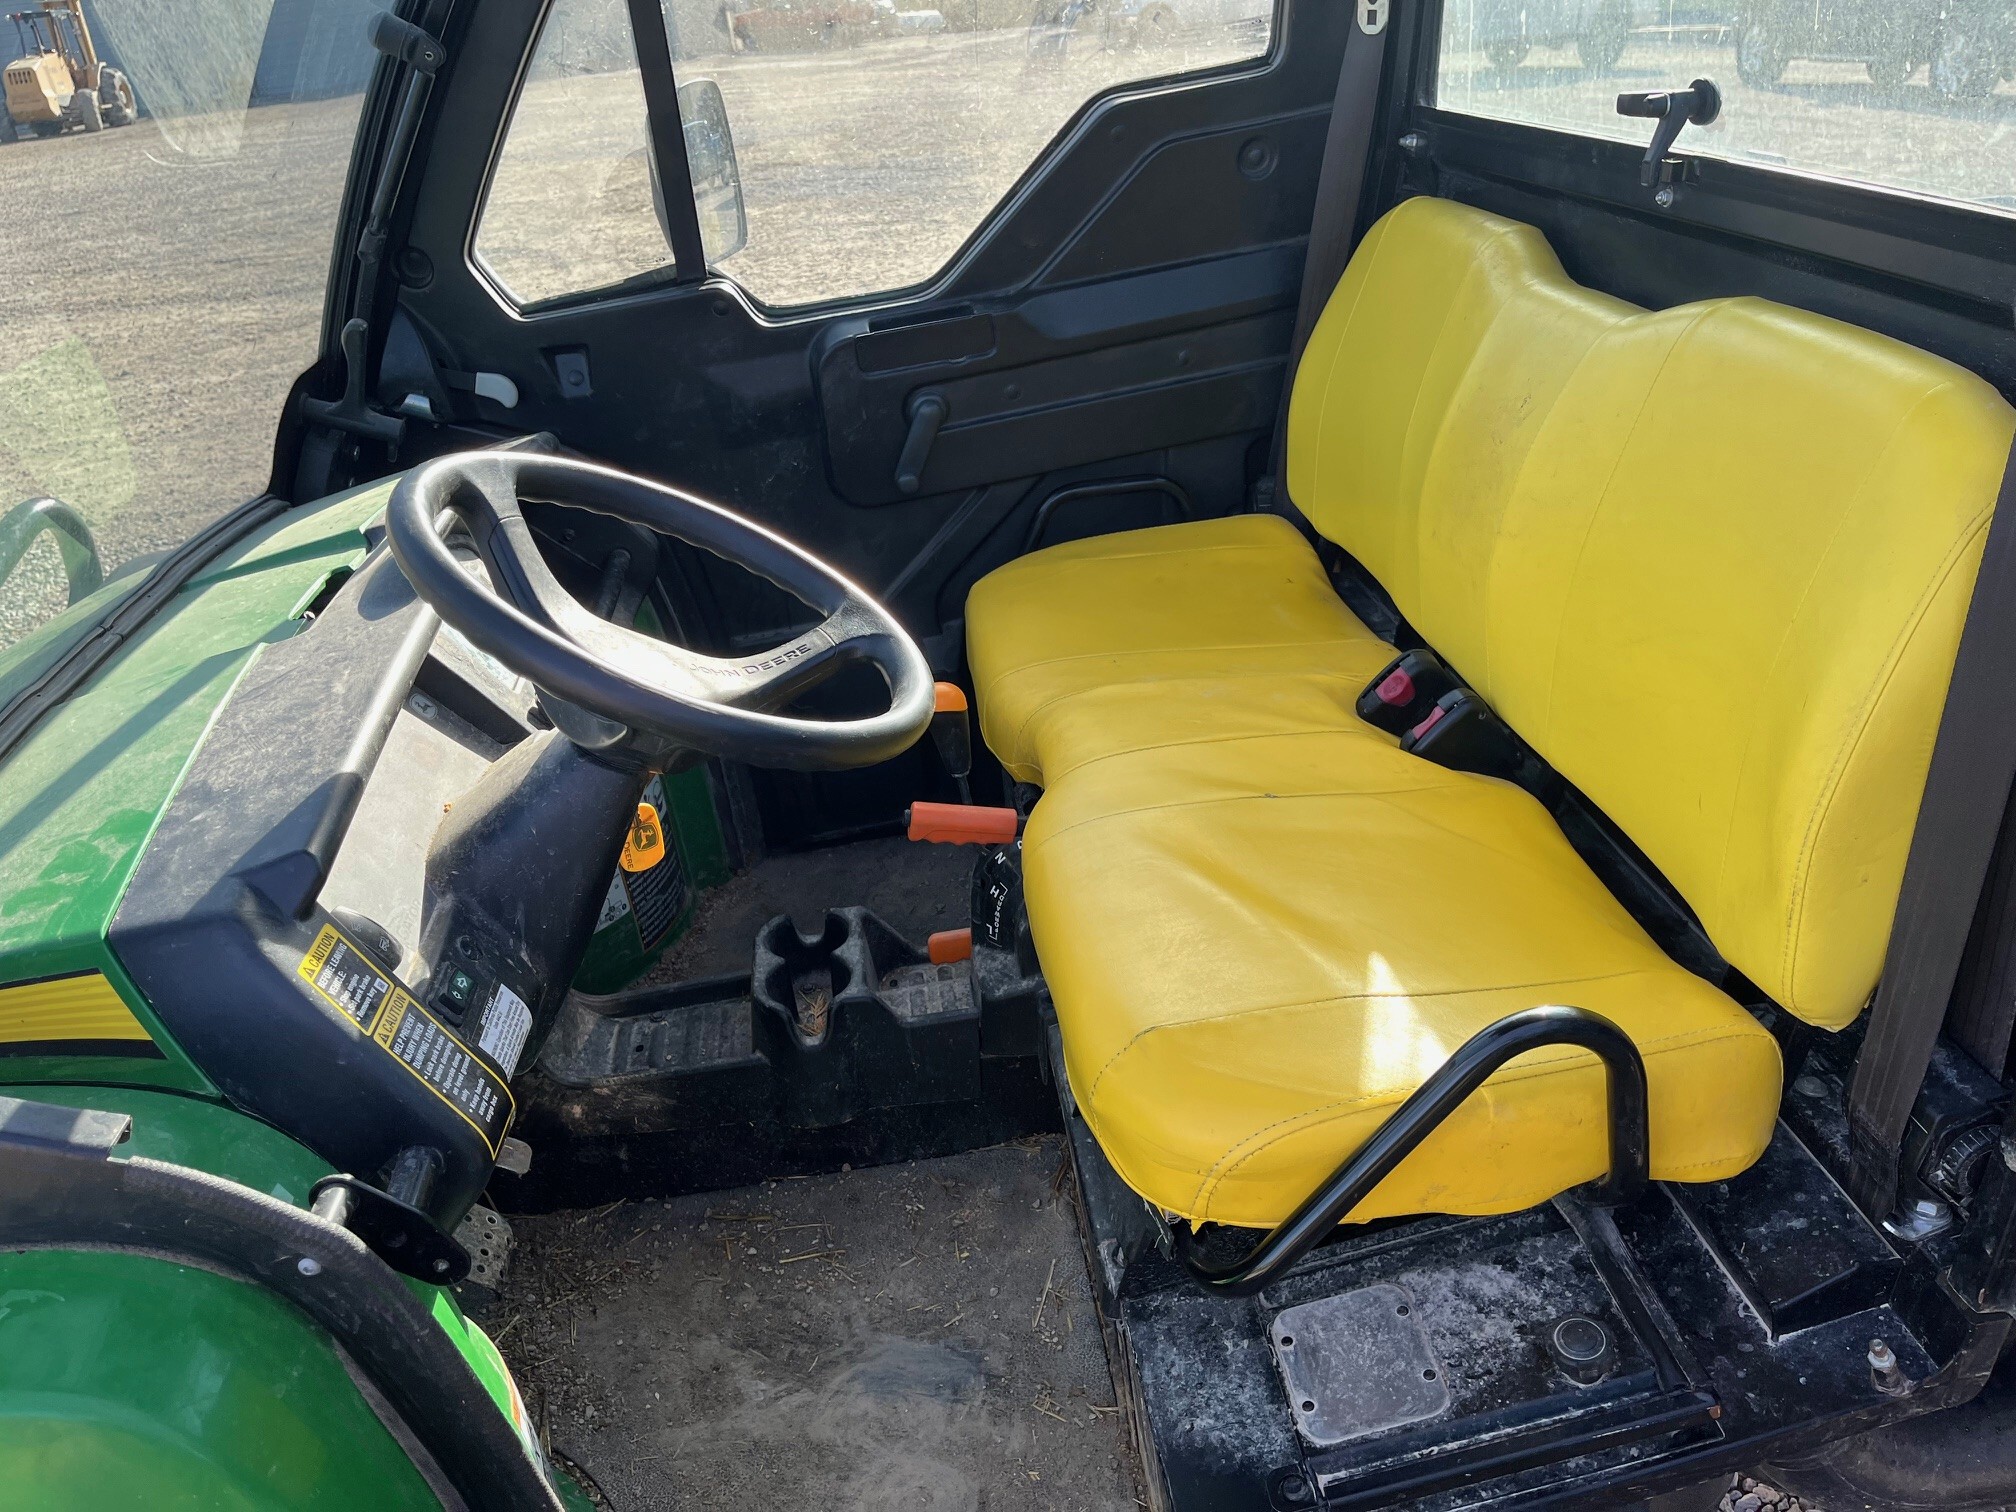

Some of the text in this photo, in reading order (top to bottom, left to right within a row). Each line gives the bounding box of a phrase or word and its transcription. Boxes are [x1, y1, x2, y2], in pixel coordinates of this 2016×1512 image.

[689, 643, 811, 677] JOHN DEERE
[624, 842, 634, 870] DEERE
[994, 851, 1006, 864] N
[990, 885, 999, 898] H
[309, 932, 334, 968] CAUTION
[317, 943, 347, 988] BEFORE LEAVING
[340, 974, 359, 1003] Stop engine
[347, 975, 371, 1011] Set park brake
[356, 987, 377, 1017] Remove key
[382, 993, 406, 1033] CAUTION
[480, 996, 494, 1025] IMPORTANT
[393, 1013, 415, 1055] HELP PREVENT
[403, 1022, 424, 1062] INJURY WHEN
[413, 1022, 436, 1069] DUMPING LOADS
[424, 1035, 445, 1075] Lock park brake
[433, 1041, 454, 1082] before dumping
[443, 1052, 462, 1089] Operate dump
[453, 1054, 471, 1095] on level ground
[461, 1089, 469, 1102] only
[470, 1078, 485, 1109] Keep hands
[478, 1087, 491, 1115] away from
[486, 1095, 498, 1122] cargo box
